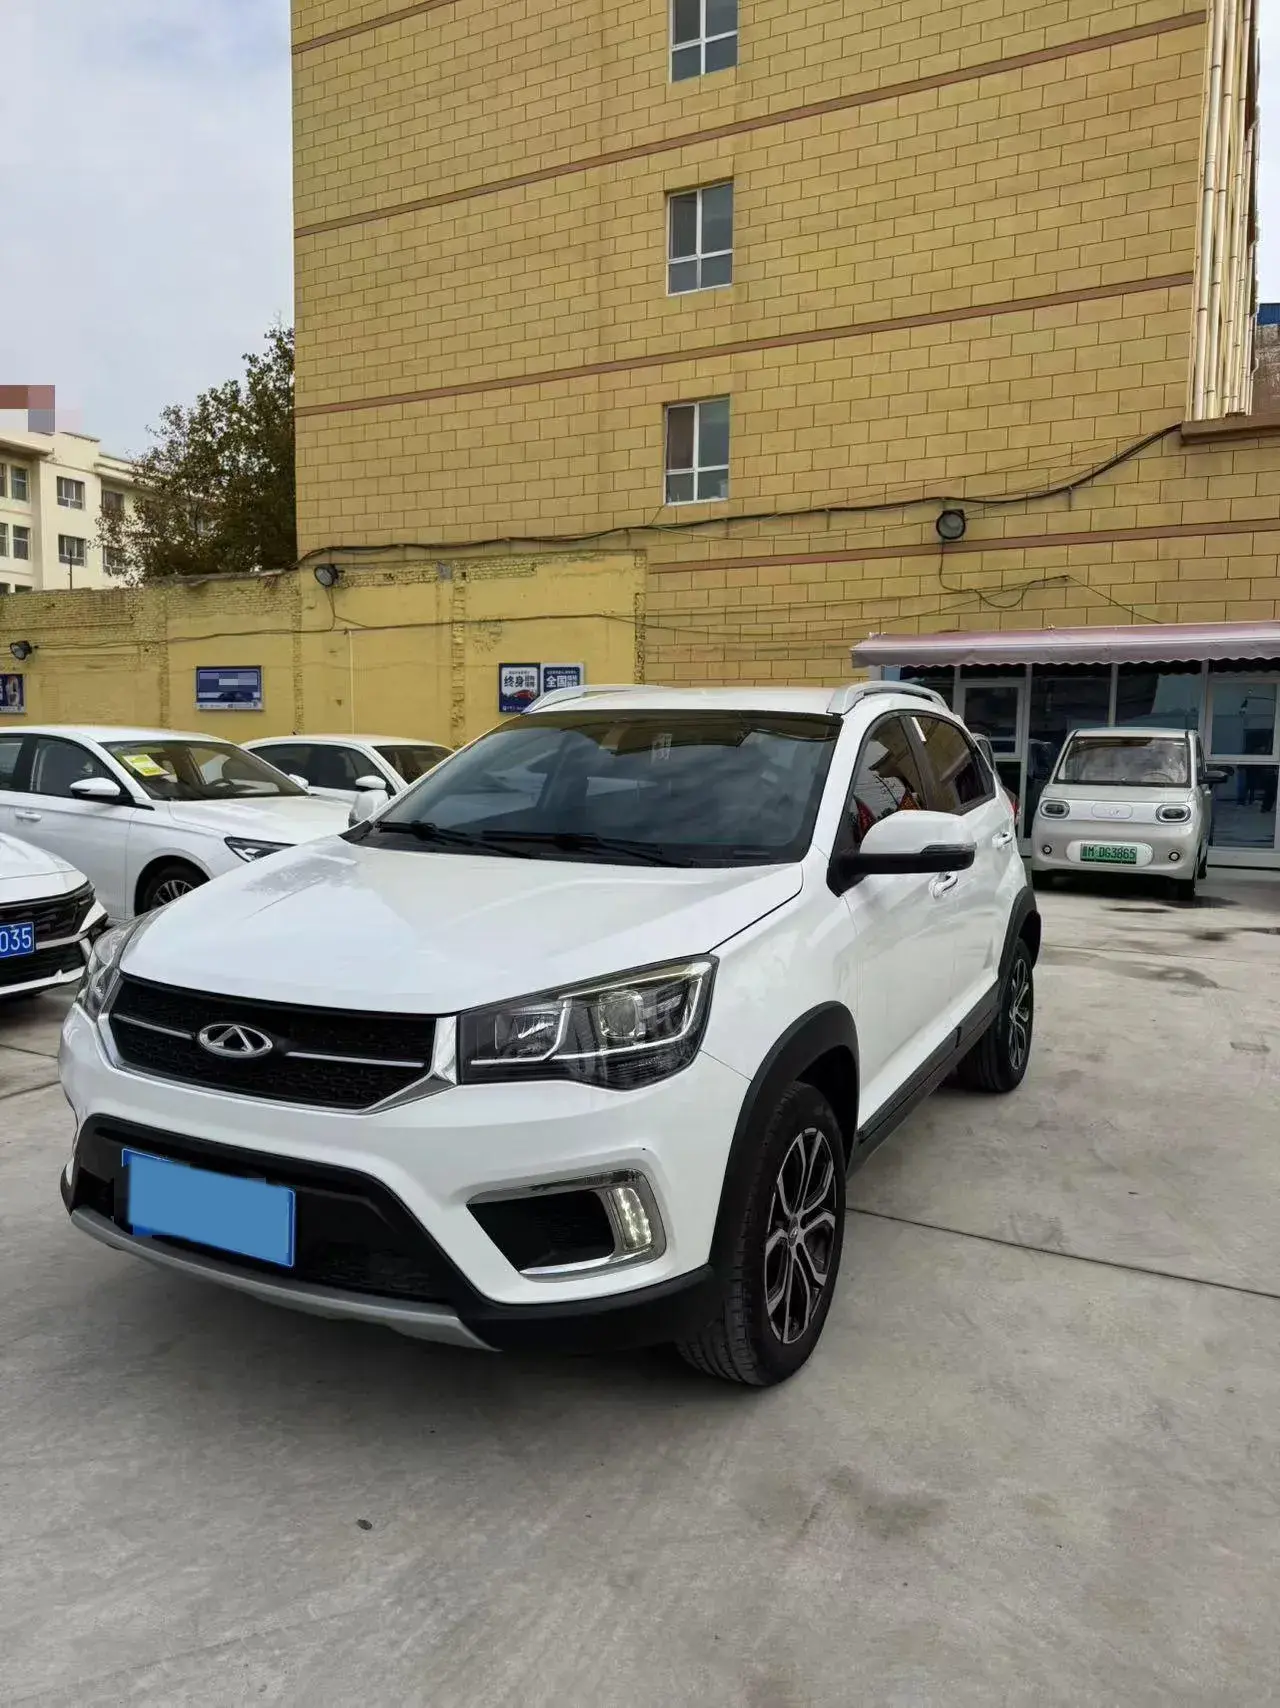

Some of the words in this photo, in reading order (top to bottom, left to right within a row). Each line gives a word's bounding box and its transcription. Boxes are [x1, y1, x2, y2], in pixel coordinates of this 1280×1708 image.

[503, 675, 524, 688] 终身
[546, 675, 567, 688] 全国
[0, 927, 32, 952] 035
